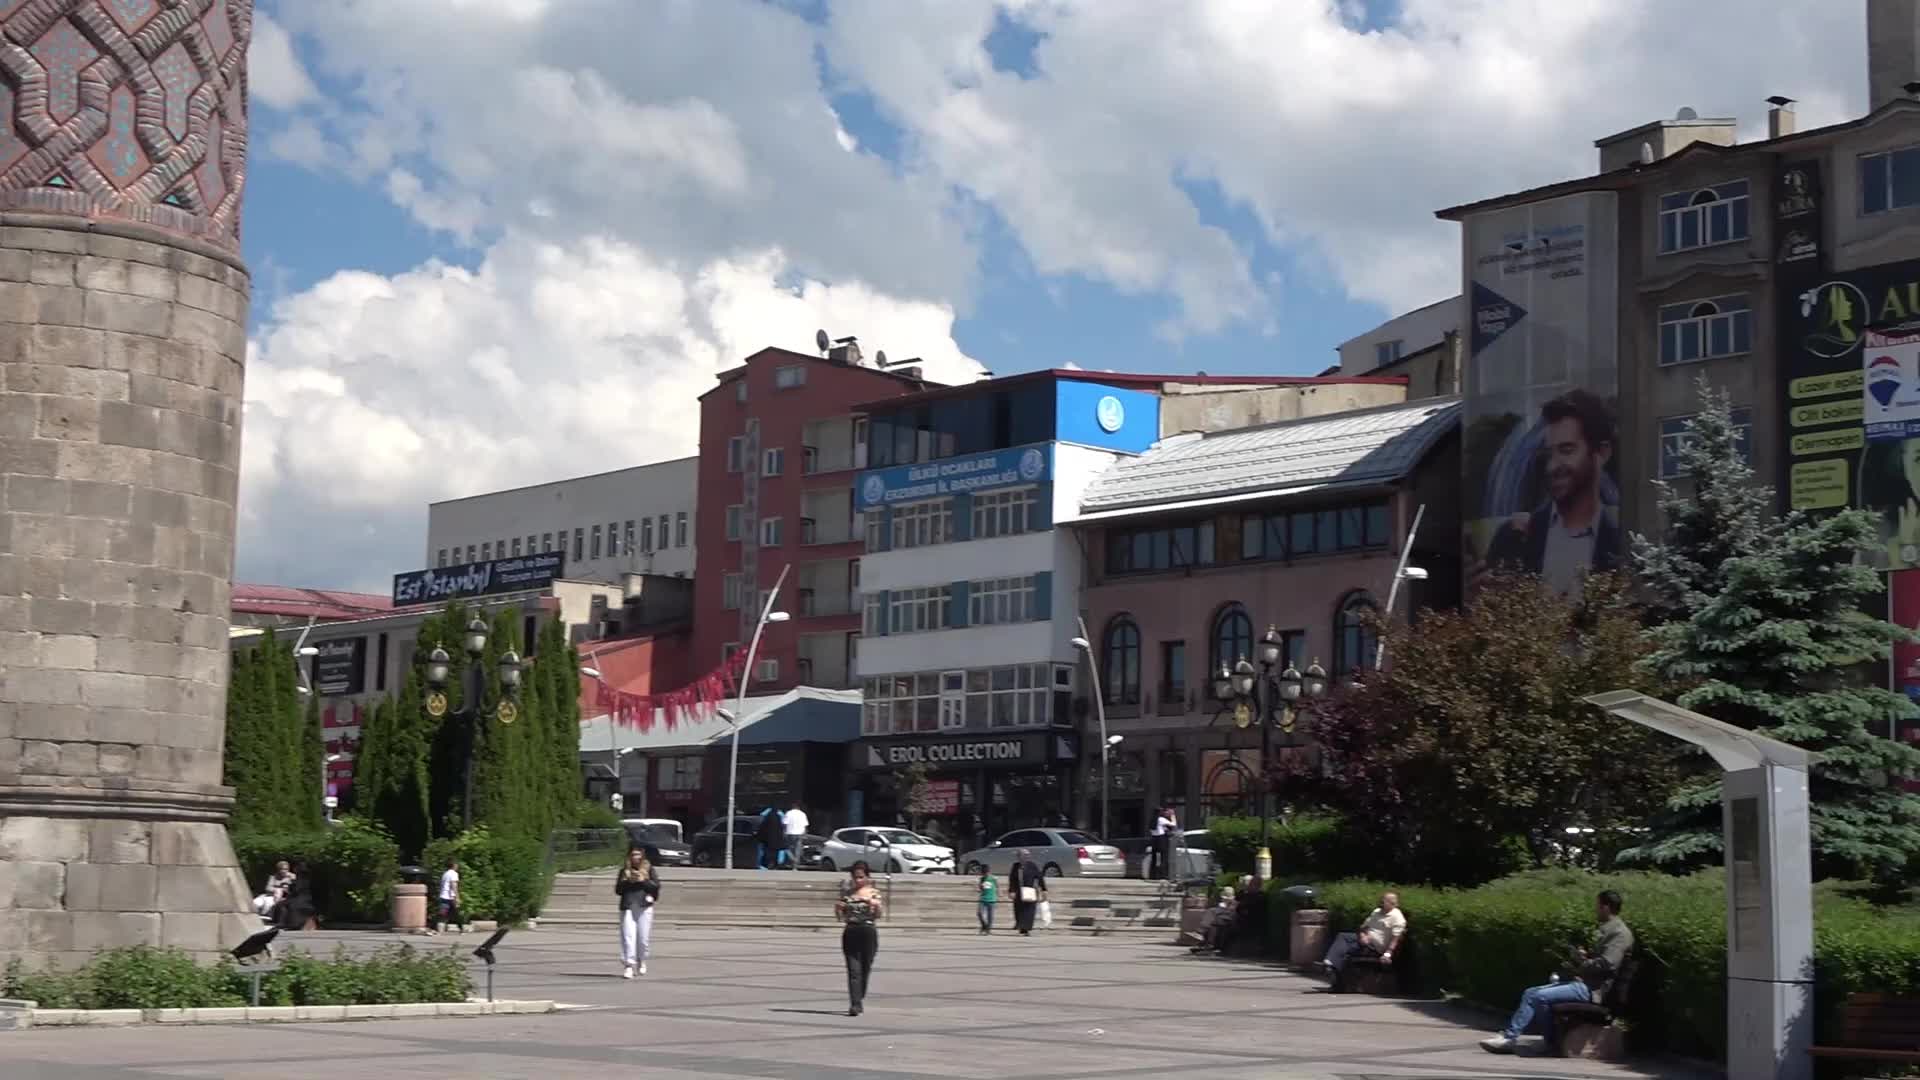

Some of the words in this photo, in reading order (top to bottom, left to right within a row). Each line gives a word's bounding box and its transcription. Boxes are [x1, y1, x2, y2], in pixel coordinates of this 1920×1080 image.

[1797, 378, 1832, 394] Lazer
[1794, 433, 1861, 451] Dermapen
[889, 745, 926, 764] EROL
[929, 741, 1022, 761] COLLECTION
